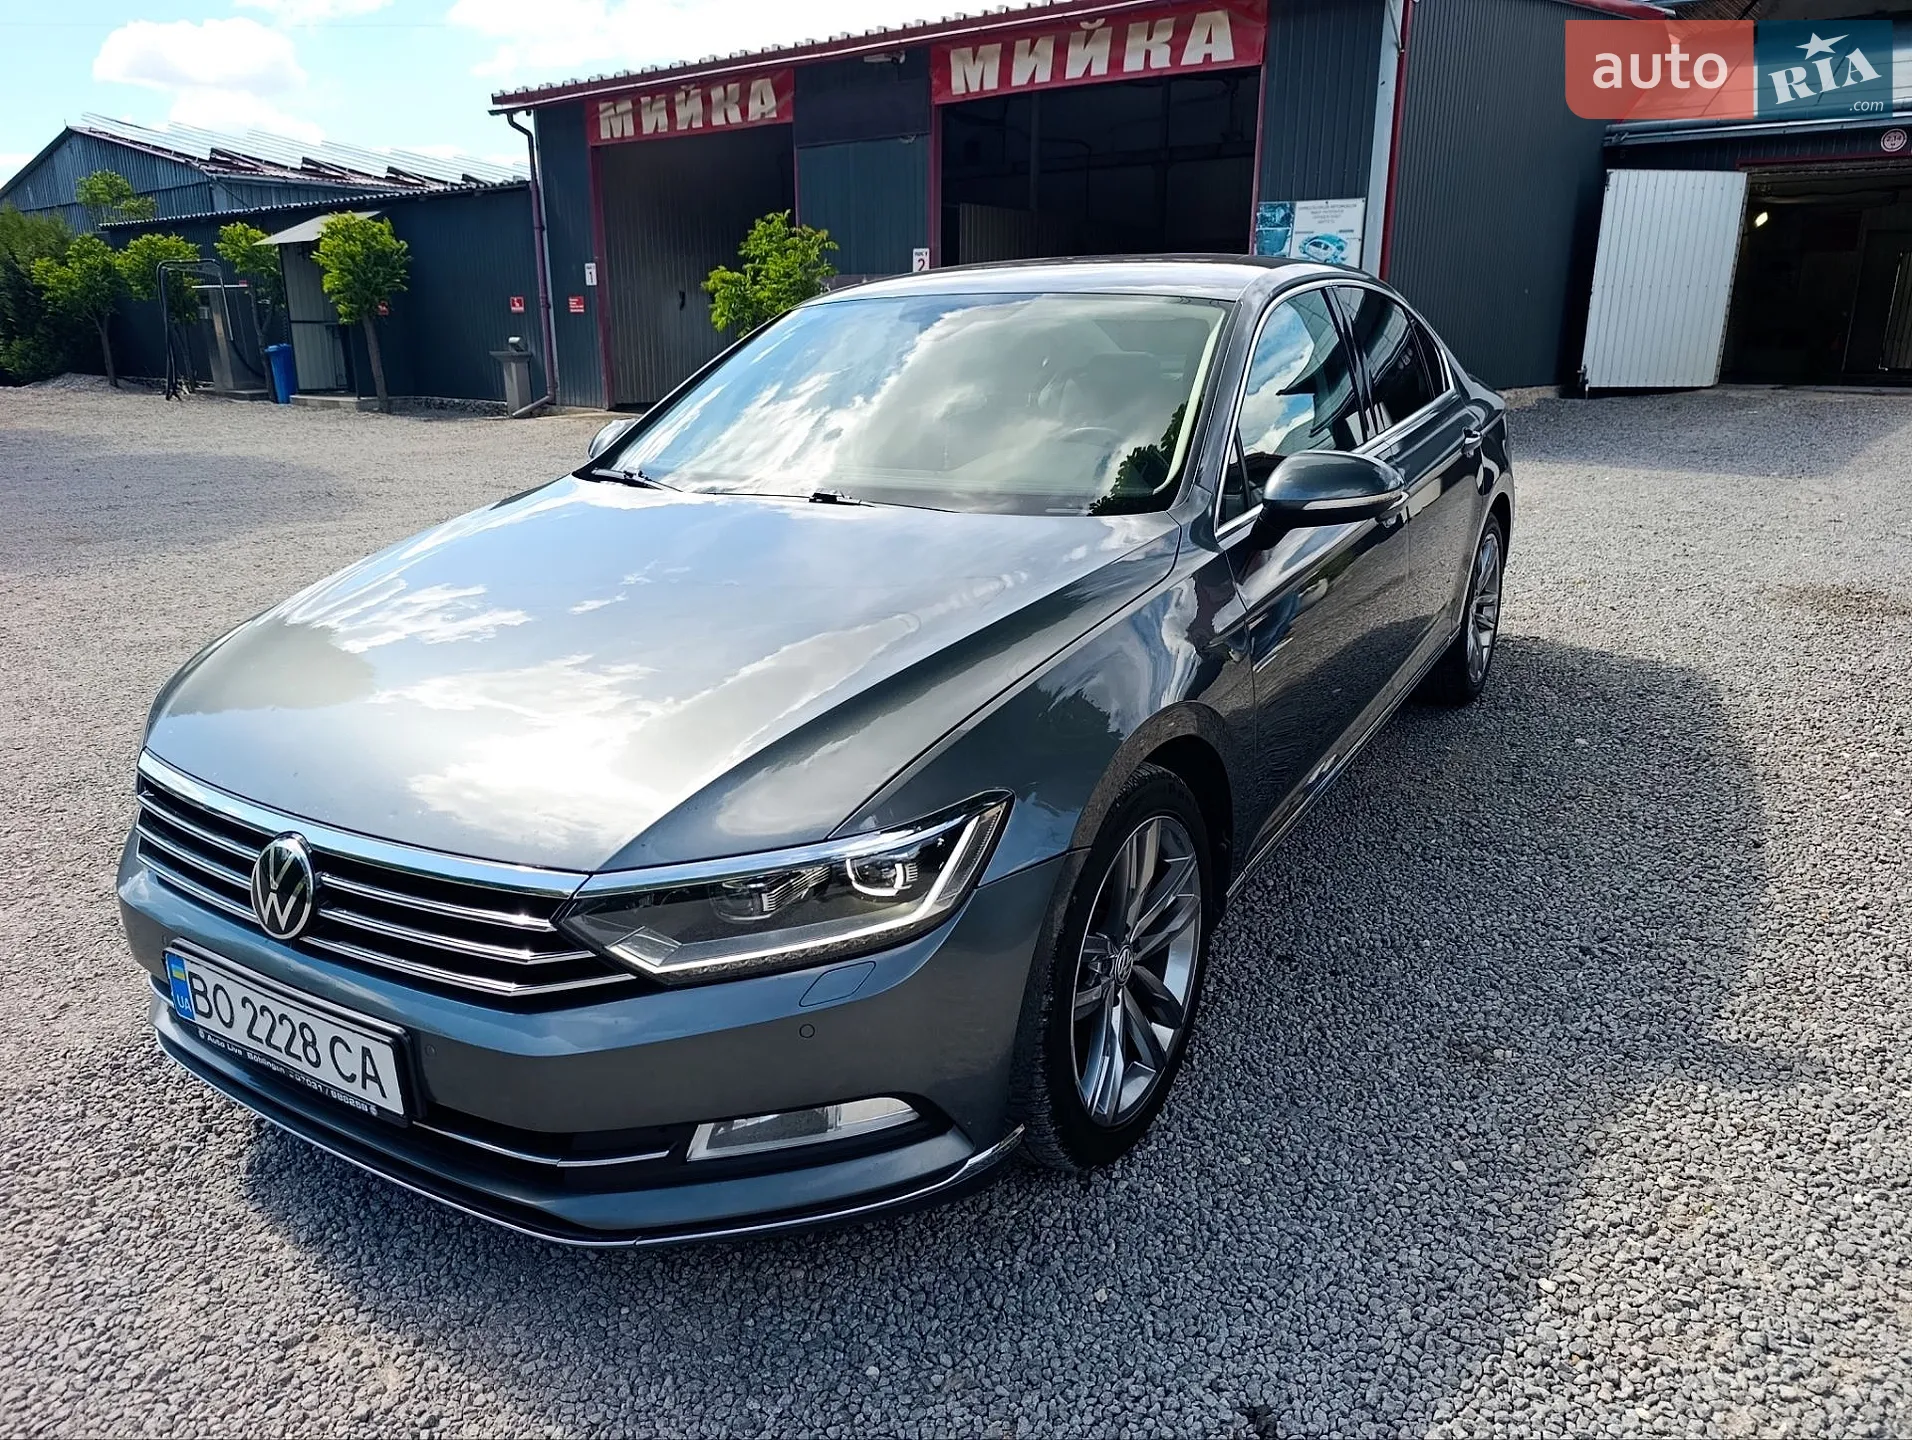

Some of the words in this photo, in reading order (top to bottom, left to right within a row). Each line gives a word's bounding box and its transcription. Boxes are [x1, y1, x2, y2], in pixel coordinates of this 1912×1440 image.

[950, 10, 1235, 96] МИЙКА
[598, 78, 778, 140] МИЙКА
[917, 258, 926, 272] 2
[252, 837, 312, 938] VW
[176, 993, 192, 1013] UA
[188, 972, 234, 1029] BO
[241, 996, 322, 1069] 2228
[330, 1034, 388, 1100] CA
[206, 1034, 226, 1048] Auto
